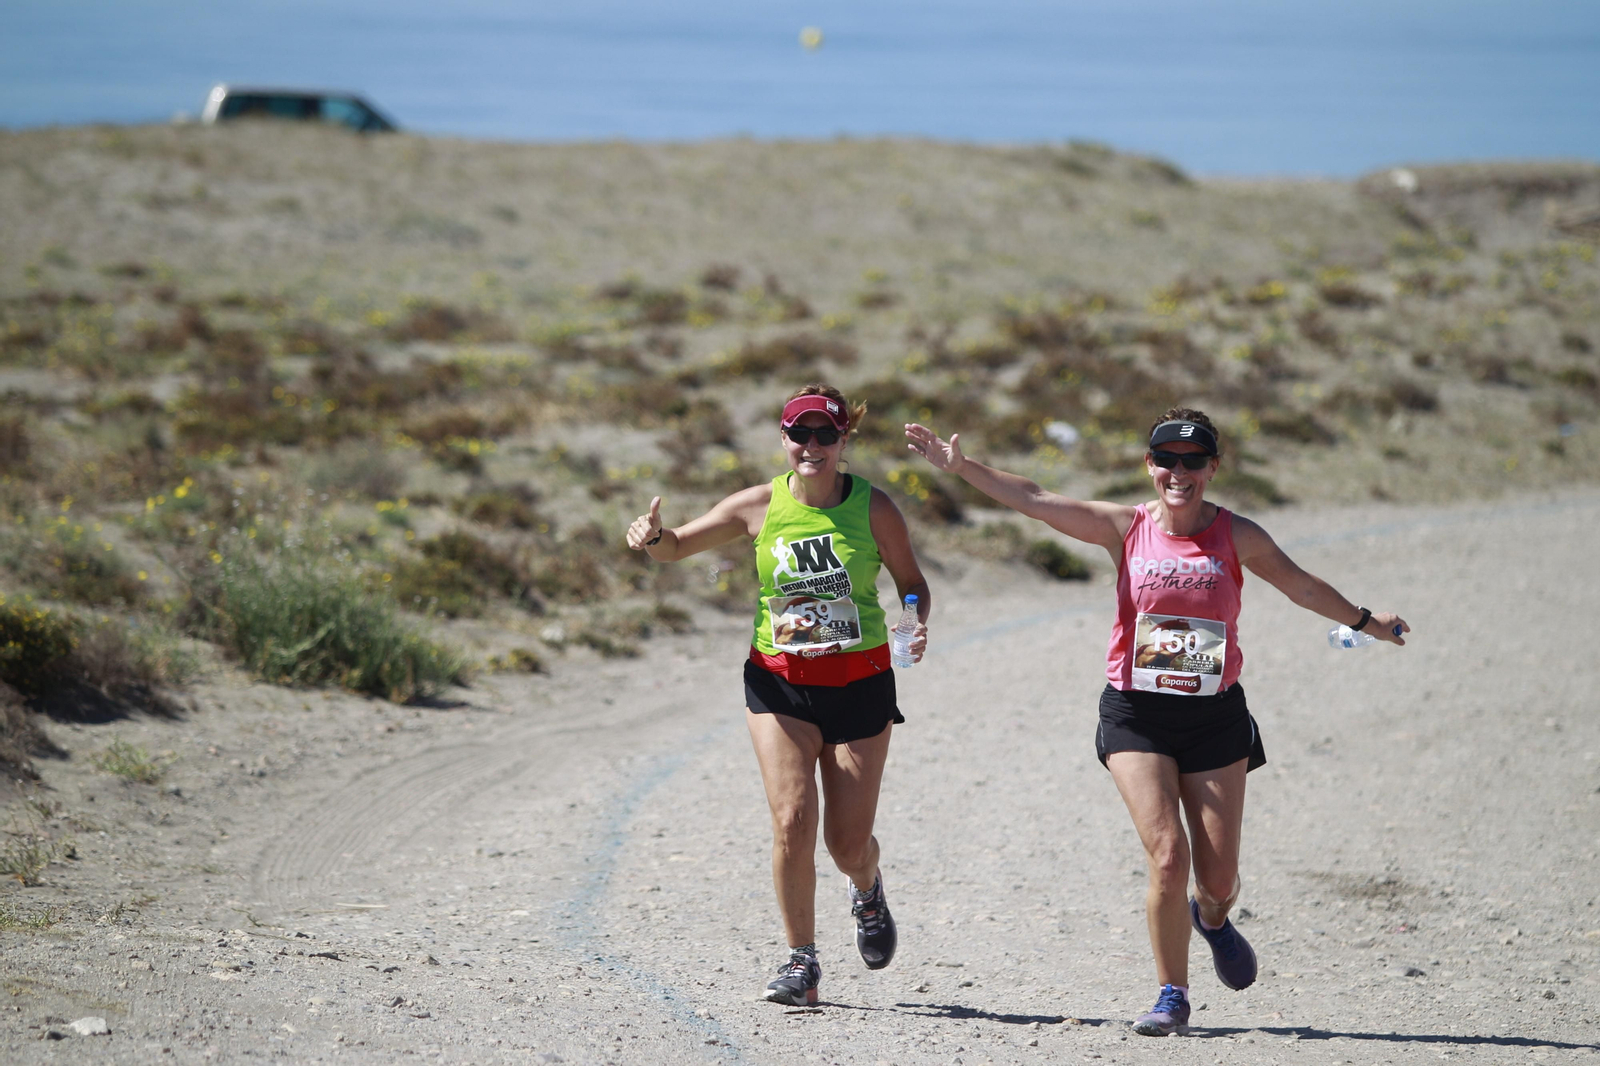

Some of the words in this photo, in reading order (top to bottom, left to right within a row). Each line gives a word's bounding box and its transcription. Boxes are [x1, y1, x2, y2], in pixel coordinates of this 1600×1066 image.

[790, 536, 842, 574] XX
[1130, 556, 1225, 577] Reebok
[781, 580, 807, 594] MEDIO
[784, 601, 833, 629] 159
[1149, 627, 1201, 655] 150
